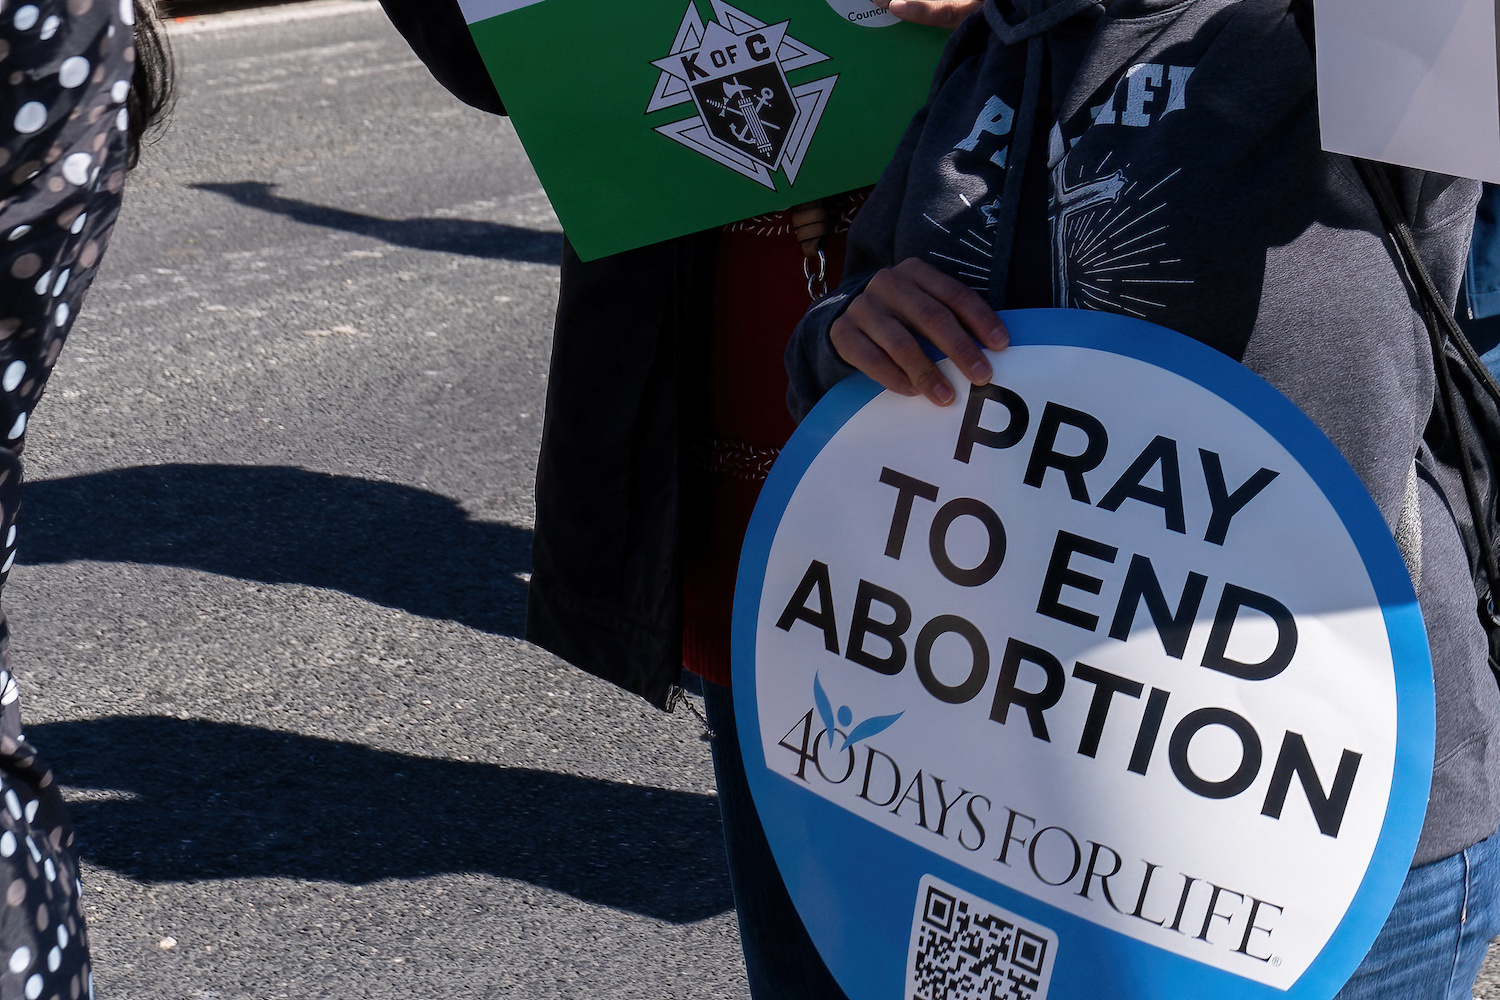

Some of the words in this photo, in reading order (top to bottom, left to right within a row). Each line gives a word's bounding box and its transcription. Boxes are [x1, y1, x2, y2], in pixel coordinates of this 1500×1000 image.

[681, 52, 710, 82] K
[710, 45, 737, 68] OF
[745, 34, 771, 61] C
[953, 382, 1280, 546] PRAY
[877, 466, 1007, 588] TO
[1036, 529, 1299, 682] END
[775, 559, 1363, 839] ABORTION
[778, 707, 855, 785] 40
[856, 744, 991, 852] DAYS
[994, 806, 1124, 916] FOR
